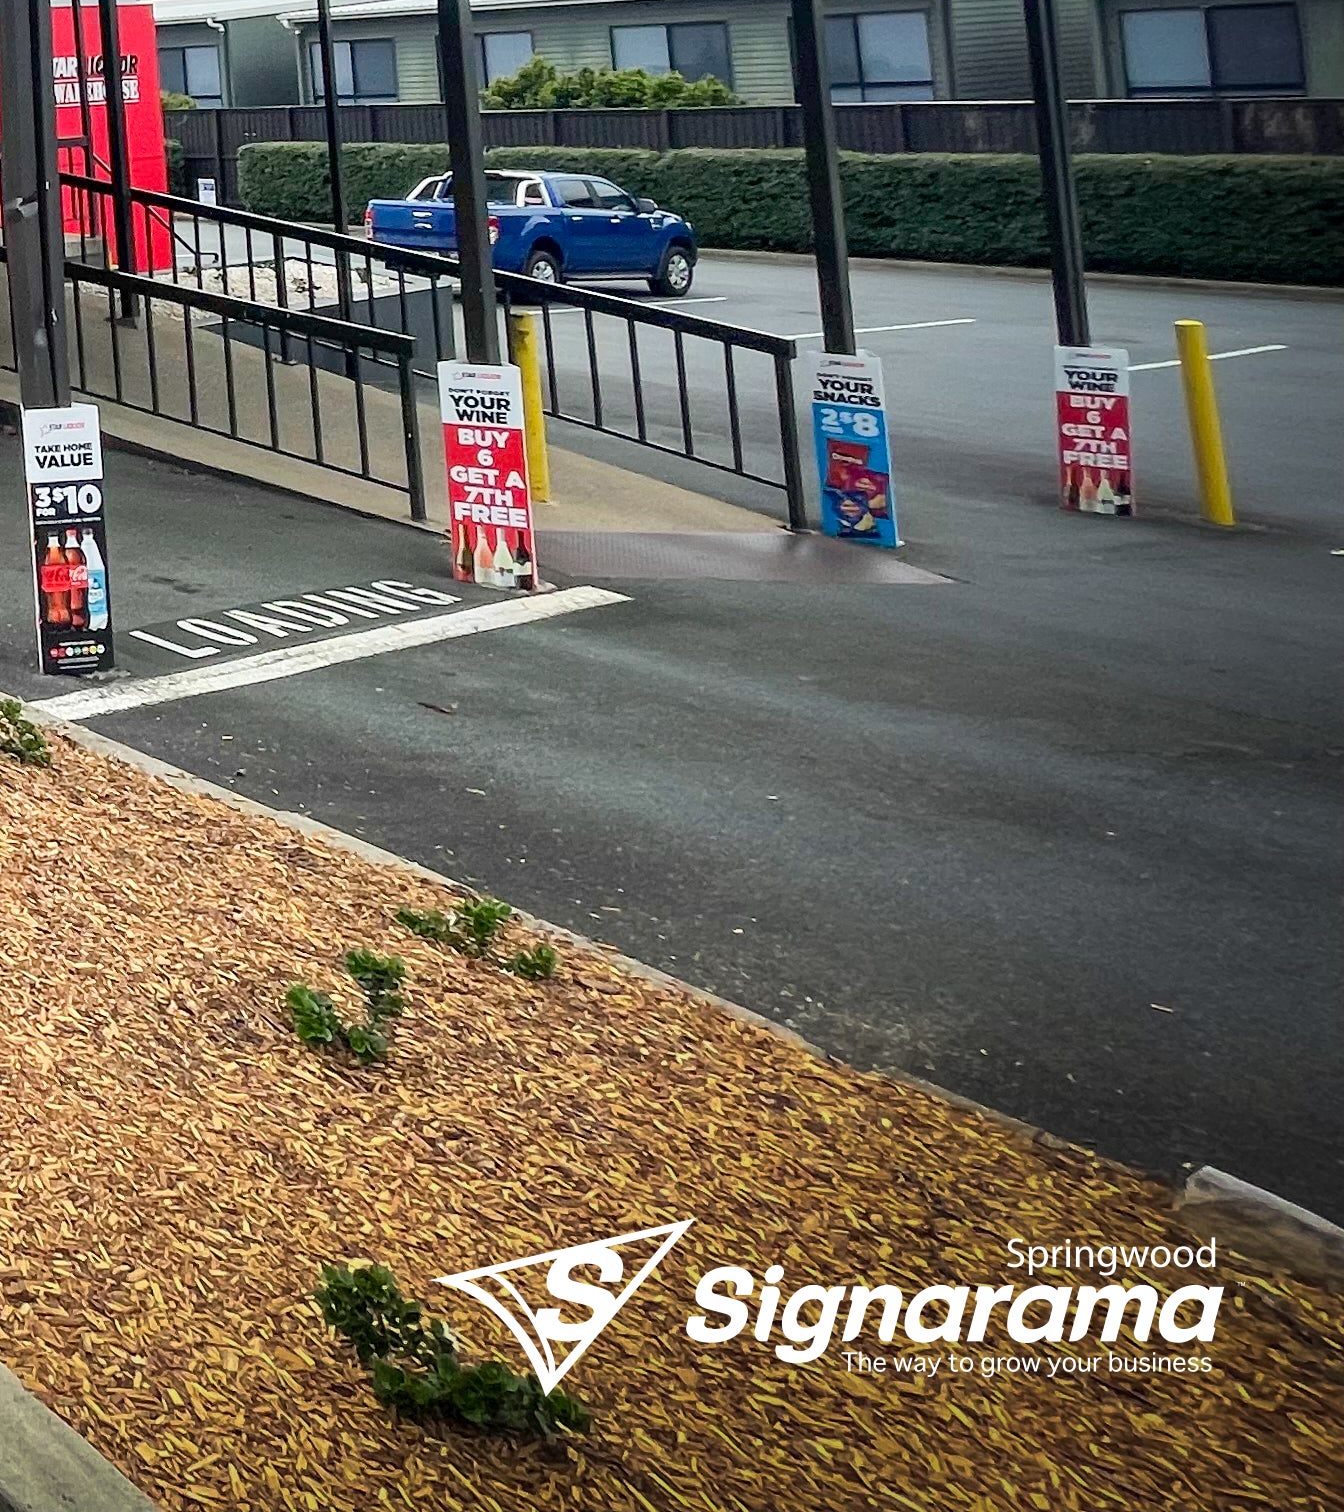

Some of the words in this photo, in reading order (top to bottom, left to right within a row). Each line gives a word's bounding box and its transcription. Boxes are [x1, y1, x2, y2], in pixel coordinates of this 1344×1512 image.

[52, 56, 79, 78] TAR
[818, 379, 874, 395] YOUR
[449, 394, 511, 412] YOUR
[813, 391, 881, 407] SNACKS
[1069, 395, 1117, 410] BUY
[455, 408, 508, 425] WINE
[820, 408, 840, 427] 2
[1086, 411, 1102, 424] 6
[457, 428, 510, 449] BUY
[1061, 423, 1105, 438] GET
[1110, 427, 1127, 441] A
[34, 445, 61, 453] TAKE
[64, 443, 92, 452] HOME
[1072, 439, 1117, 454] 7TH
[35, 453, 94, 469] VALUE
[477, 449, 494, 467] 6
[1062, 450, 1128, 471] FREE
[450, 466, 499, 487] GET
[505, 471, 526, 489] A
[35, 486, 52, 508] 3
[464, 485, 514, 507] 7TH
[453, 502, 529, 530] FREE
[128, 579, 463, 659] LOADING
